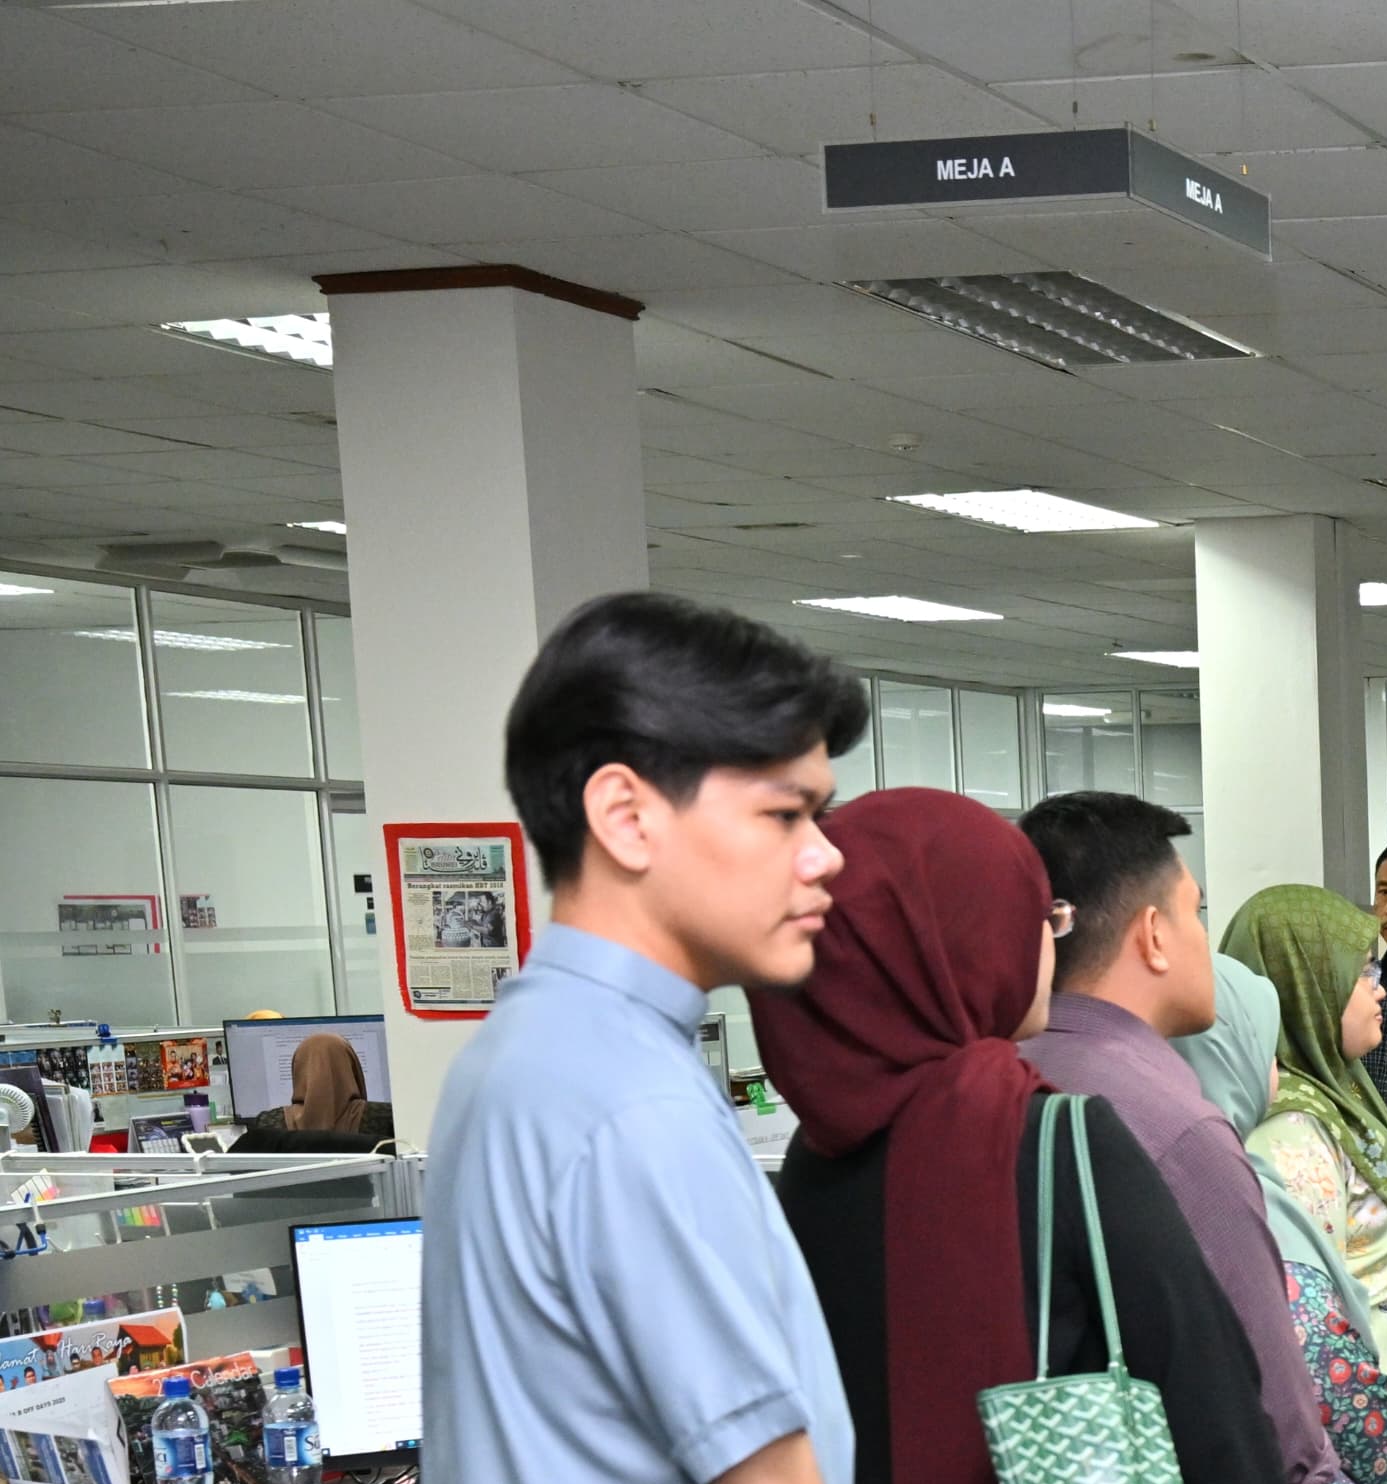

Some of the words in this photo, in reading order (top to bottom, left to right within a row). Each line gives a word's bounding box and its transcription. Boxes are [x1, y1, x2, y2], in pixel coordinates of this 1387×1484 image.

[936, 158, 994, 181] MEJA
[998, 156, 1015, 178] A
[1186, 178, 1215, 211] MEJA
[1215, 192, 1223, 215] A
[0, 1348, 40, 1370] amat
[56, 1337, 92, 1359] Hari
[93, 1333, 133, 1361] Raya
[190, 1362, 258, 1389] Calendar
